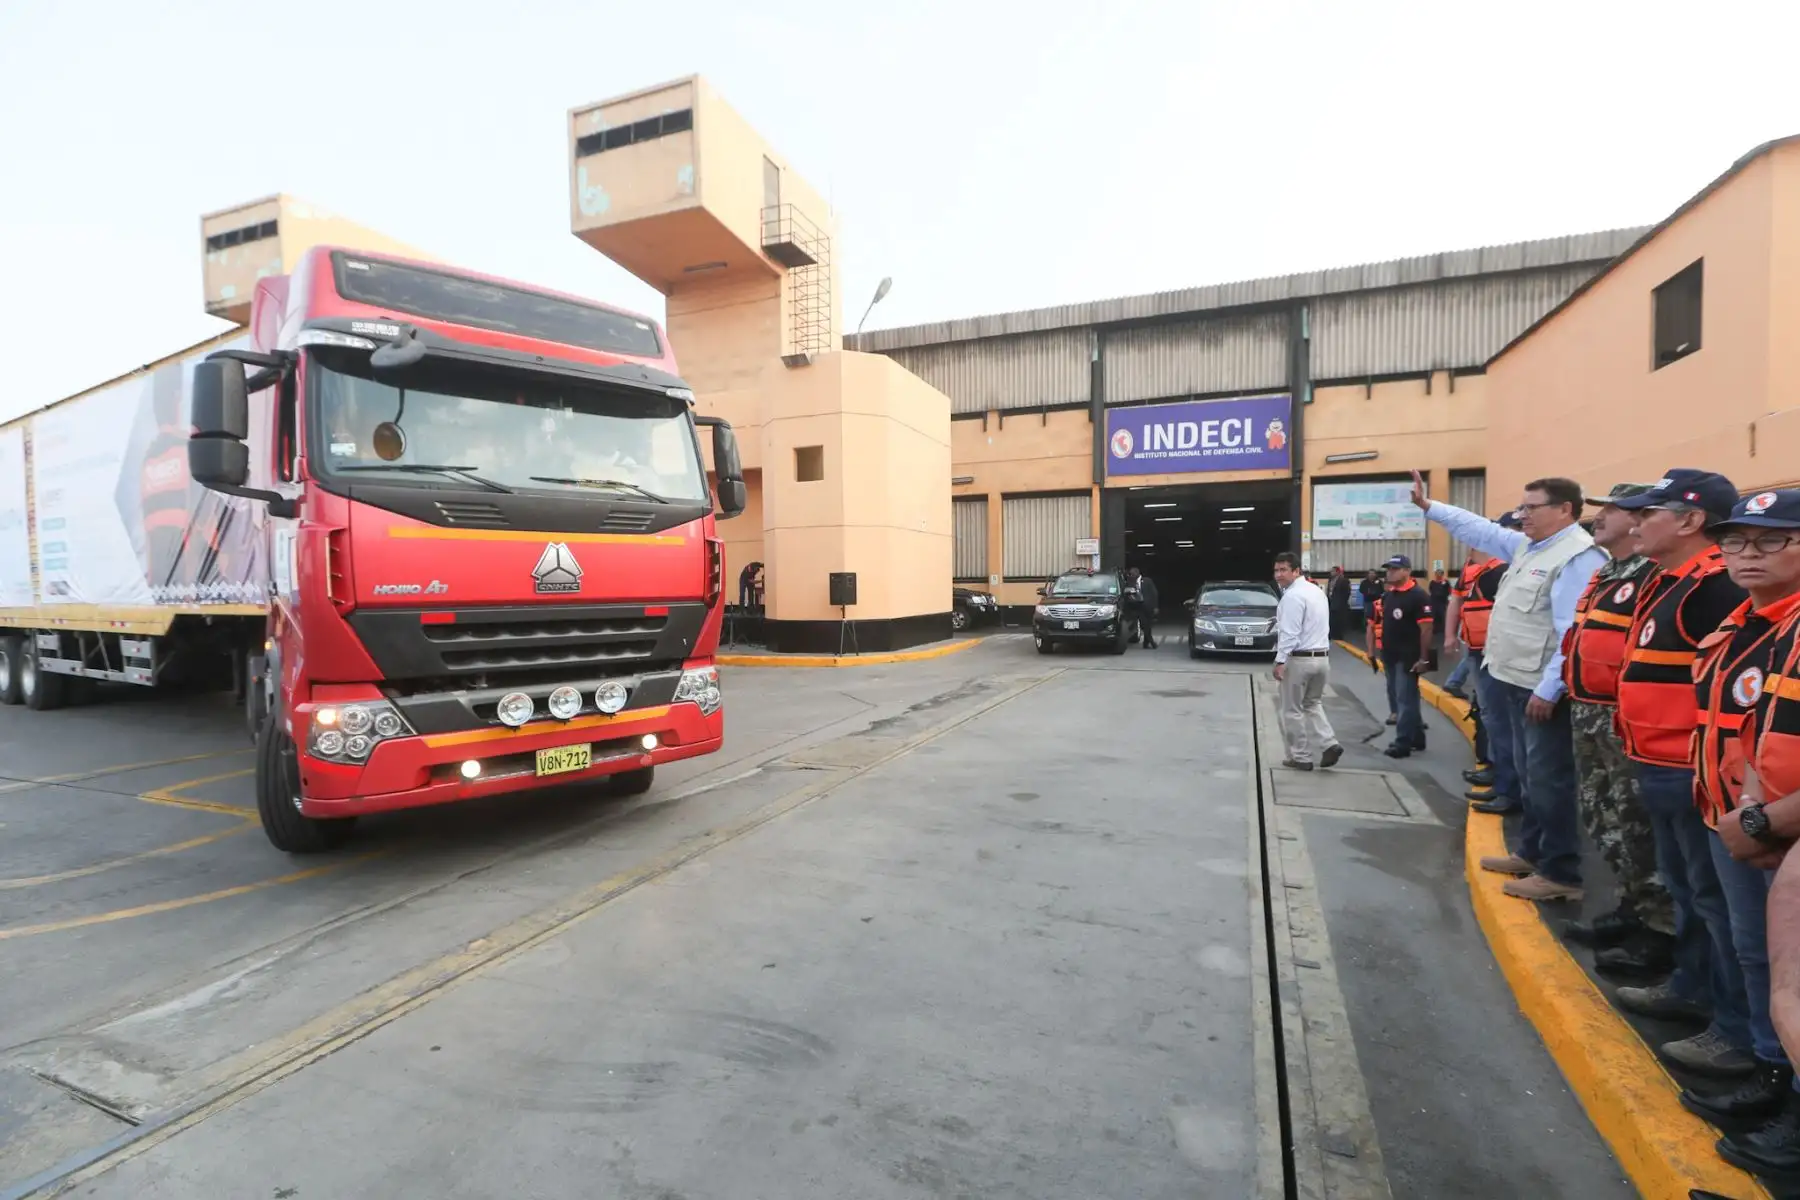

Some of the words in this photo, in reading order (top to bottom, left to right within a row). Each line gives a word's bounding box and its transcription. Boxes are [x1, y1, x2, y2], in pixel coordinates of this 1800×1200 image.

[1143, 418, 1253, 450] INDECI
[373, 584, 422, 595] HOWO
[424, 579, 449, 594] A7
[539, 751, 588, 772] V8N-712
